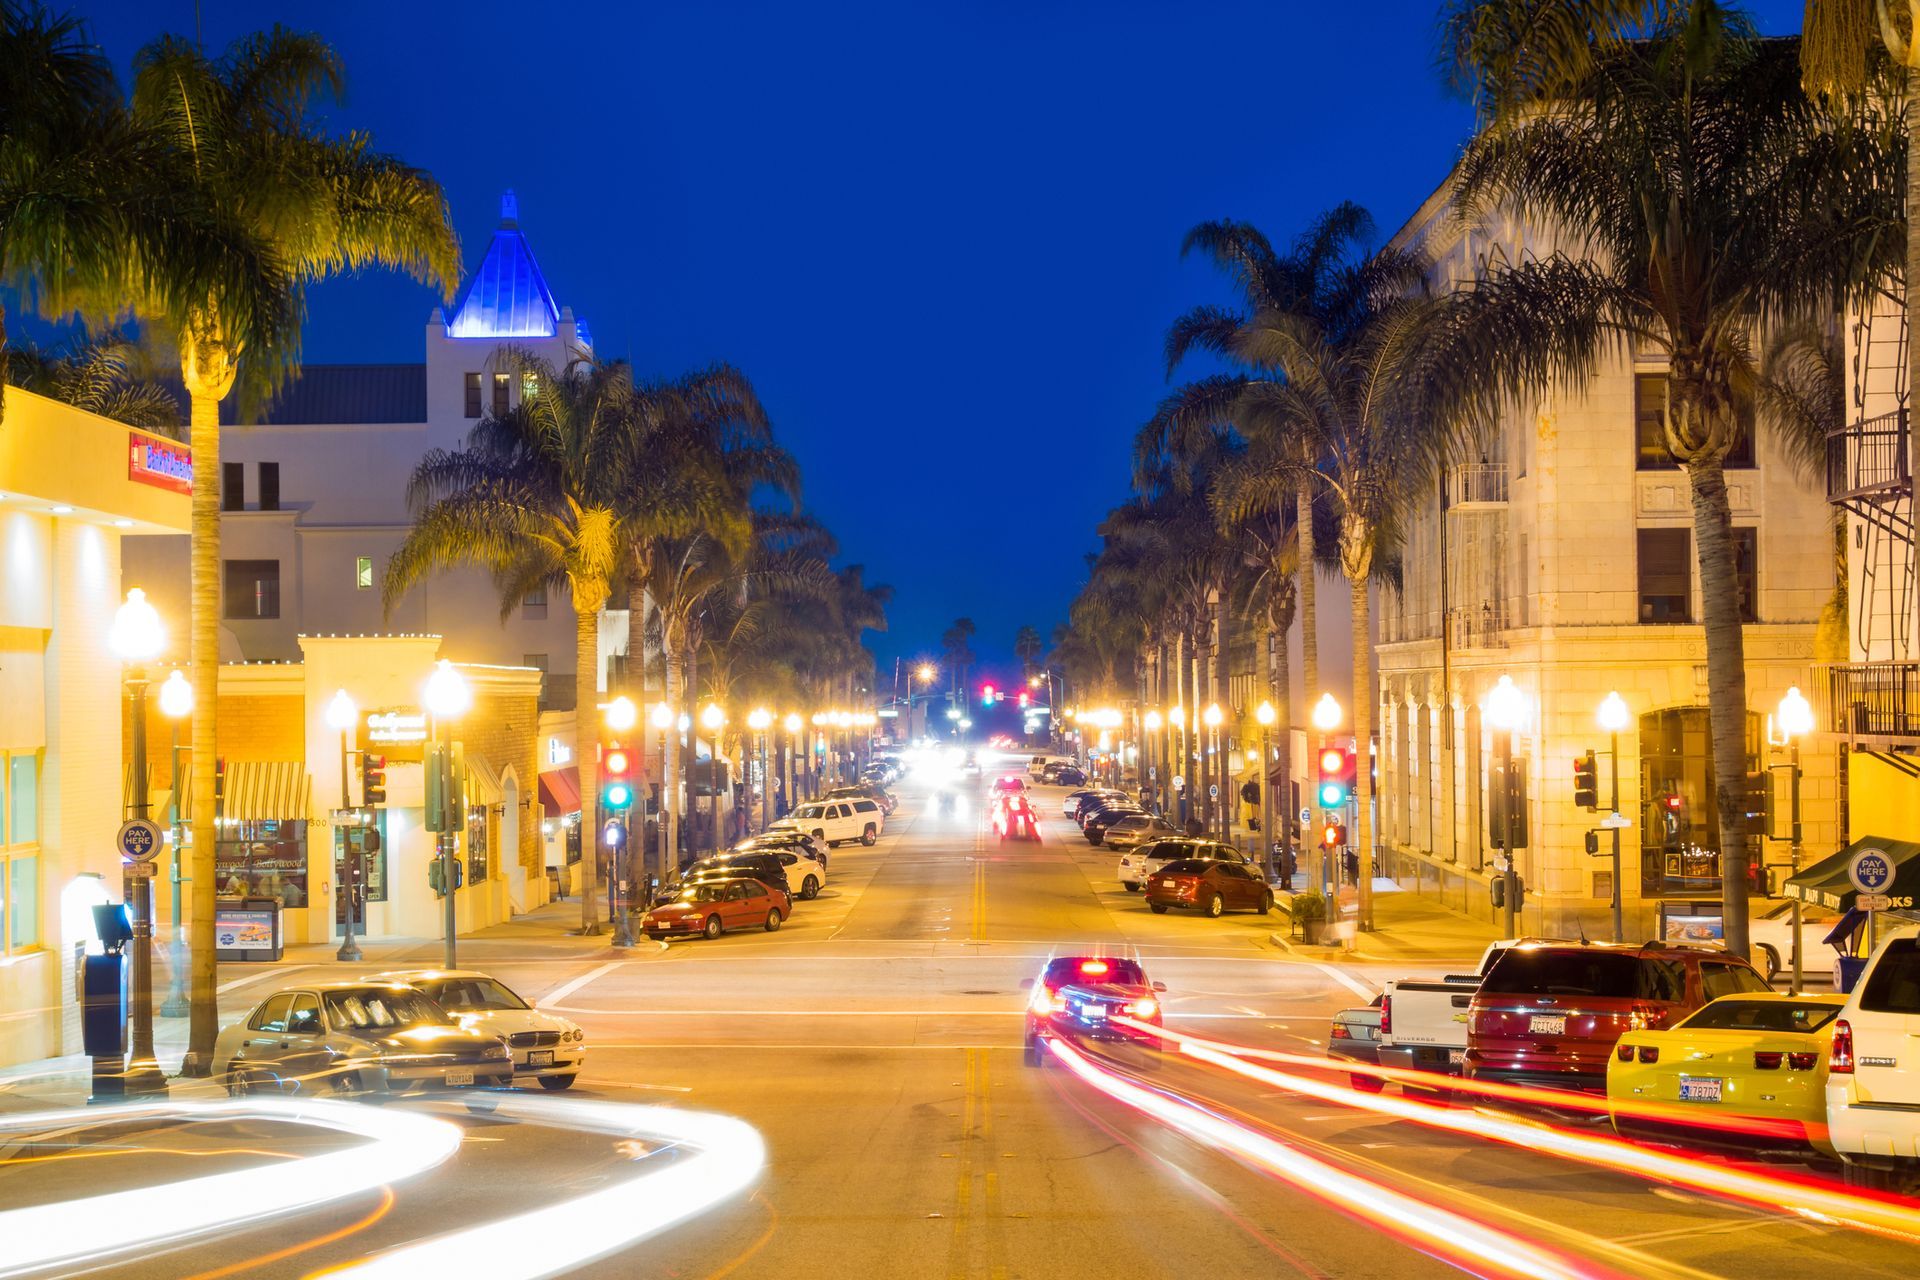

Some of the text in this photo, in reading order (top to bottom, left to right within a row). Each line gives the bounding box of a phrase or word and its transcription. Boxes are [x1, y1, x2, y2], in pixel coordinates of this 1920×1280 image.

[125, 836, 150, 845] HERE
[1861, 860, 1882, 868] PAY
[1858, 867, 1886, 876] HERE
